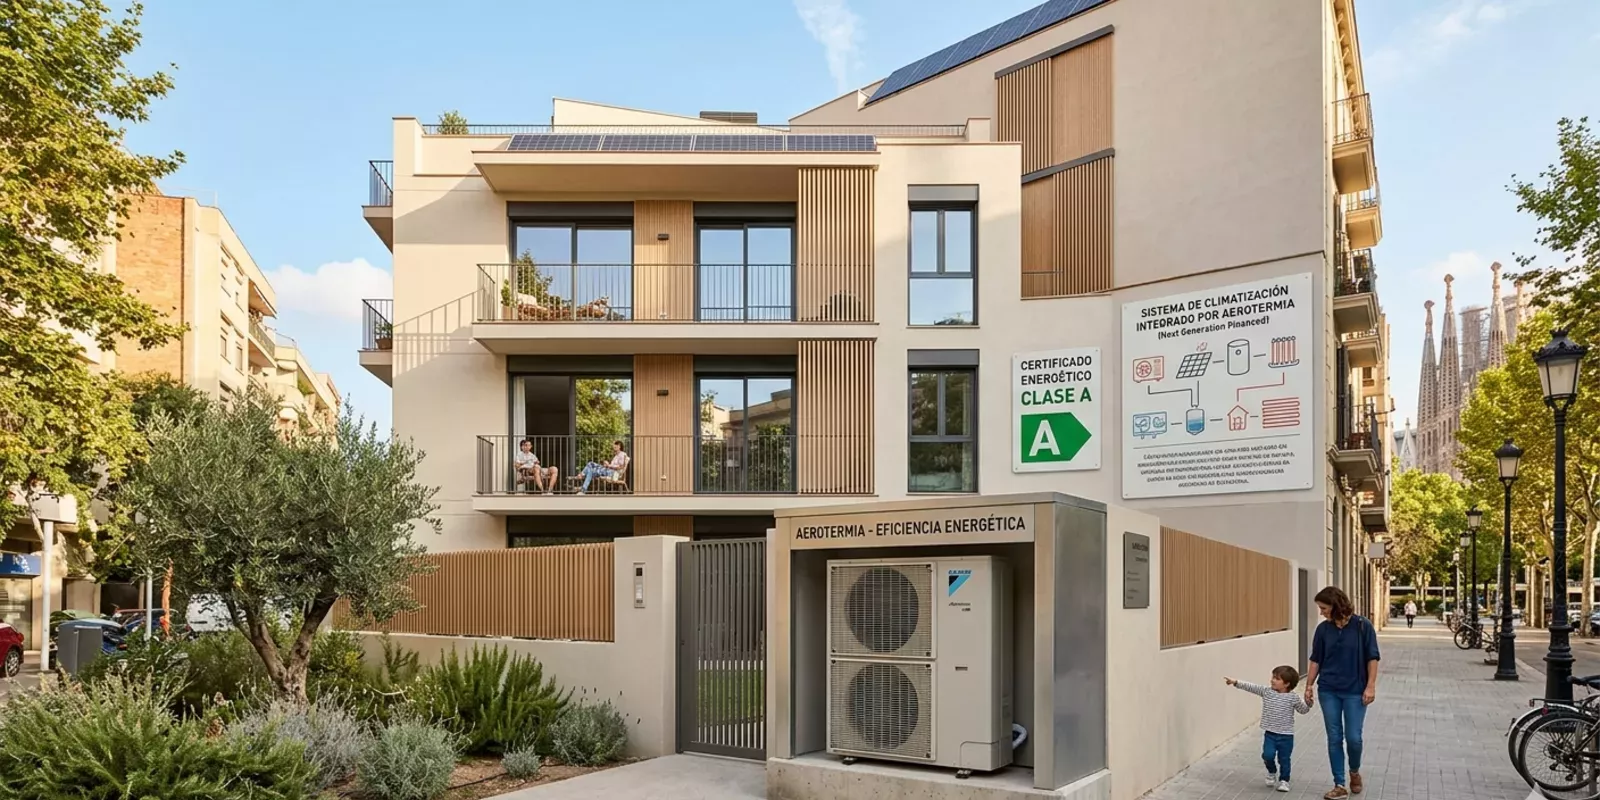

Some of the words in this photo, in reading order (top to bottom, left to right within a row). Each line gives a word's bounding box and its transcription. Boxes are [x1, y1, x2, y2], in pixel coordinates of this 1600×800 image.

[1141, 303, 1185, 317] SISTEMA
[1188, 299, 1201, 311] DE
[1204, 284, 1289, 307] CLIMATIZACIÓN
[1198, 310, 1219, 322] POR
[1222, 298, 1295, 318] AEROTERMIA
[1181, 322, 1225, 336] Generation
[1021, 356, 1092, 370] CERTIFICADO
[1021, 388, 1075, 405] CLASE
[1080, 387, 1092, 402] A
[1029, 419, 1061, 457] A
[796, 524, 865, 540] AEROTERMIA
[876, 520, 941, 536] EFICIENCIA
[945, 514, 1025, 533] ENERGÉTICA
